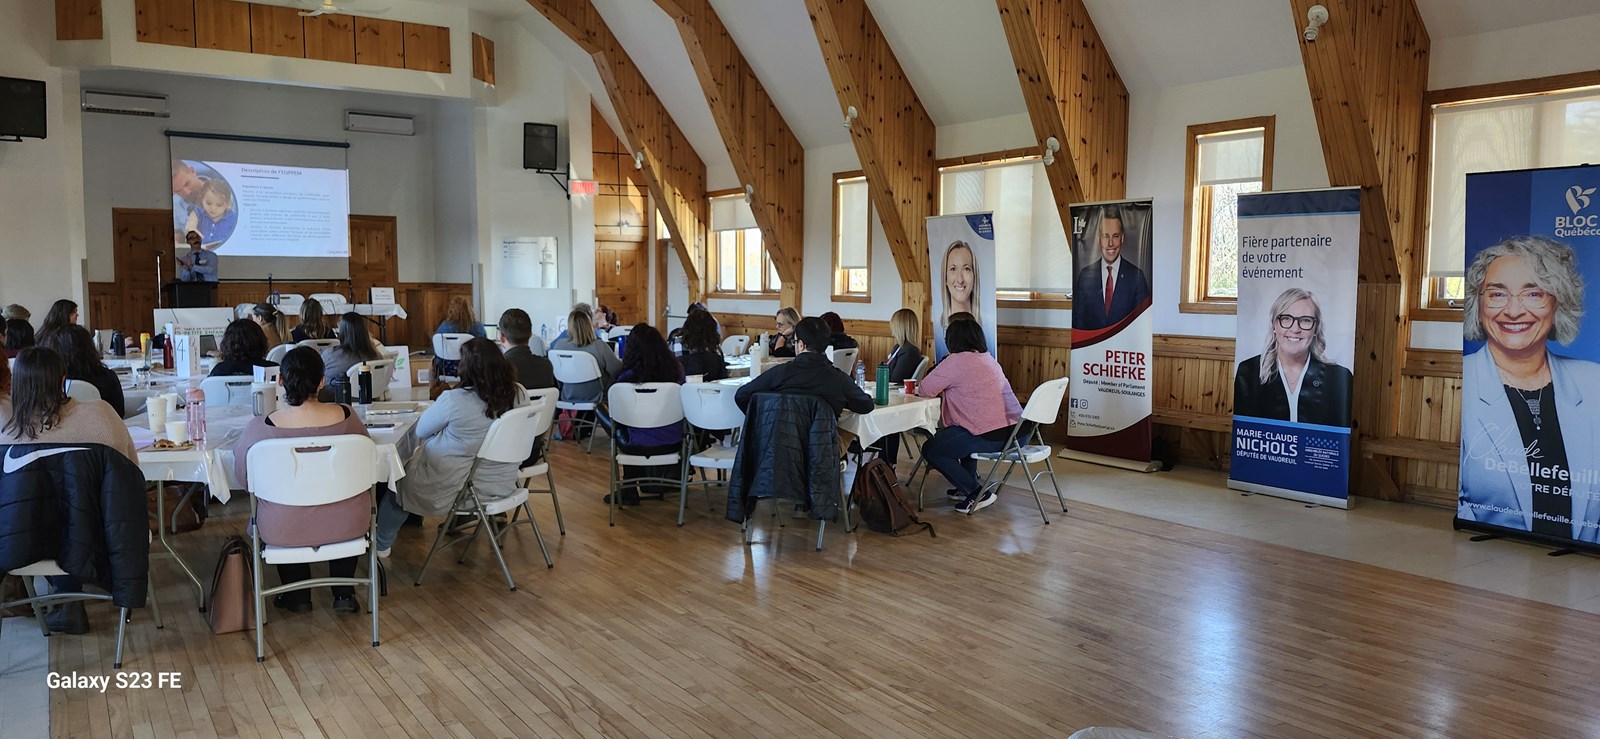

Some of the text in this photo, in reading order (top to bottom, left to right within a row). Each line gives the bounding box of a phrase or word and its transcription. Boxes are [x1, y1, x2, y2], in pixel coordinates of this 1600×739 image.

[1555, 215, 1598, 228] BLOC
[1242, 234, 1332, 250] Fière partenaire
[1242, 251, 1287, 263] de votre
[1242, 266, 1304, 278] événement
[176, 338, 187, 362] 4
[1105, 350, 1146, 365] PETER
[1083, 363, 1146, 381] SCHIEFKE
[1123, 382, 1146, 391] Parliament
[1236, 428, 1299, 443] MARIE-CLAUDE
[1236, 437, 1298, 457] NICHOLS
[1268, 454, 1297, 465] VAUDREUIL
[1485, 458, 1600, 485] DeBellefeuill
